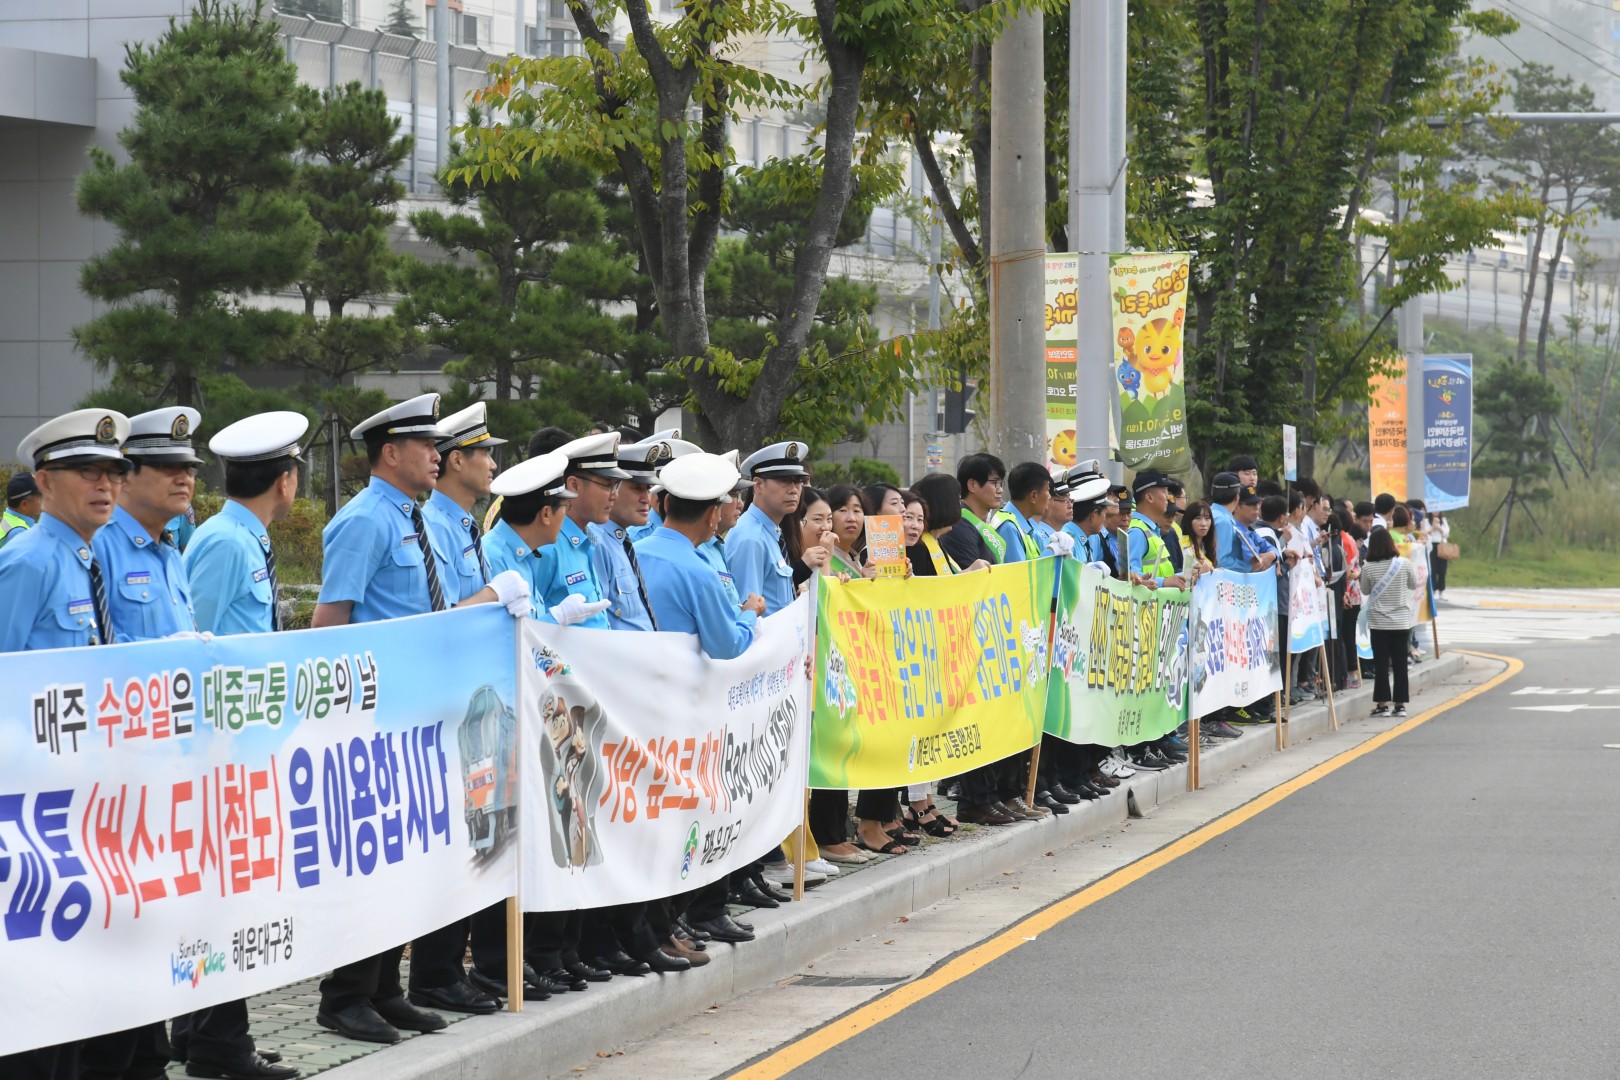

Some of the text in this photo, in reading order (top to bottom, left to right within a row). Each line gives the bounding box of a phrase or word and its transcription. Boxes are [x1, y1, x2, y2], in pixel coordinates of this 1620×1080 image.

[34, 652, 378, 755] 매주 수요일은 대중교통 이용의 날
[917, 723, 982, 767] 해운대구 교통행정과
[600, 736, 648, 823] 가방
[646, 736, 700, 820] 앞으로
[700, 819, 742, 866] 해운대구
[232, 917, 294, 972] 해운대구청
